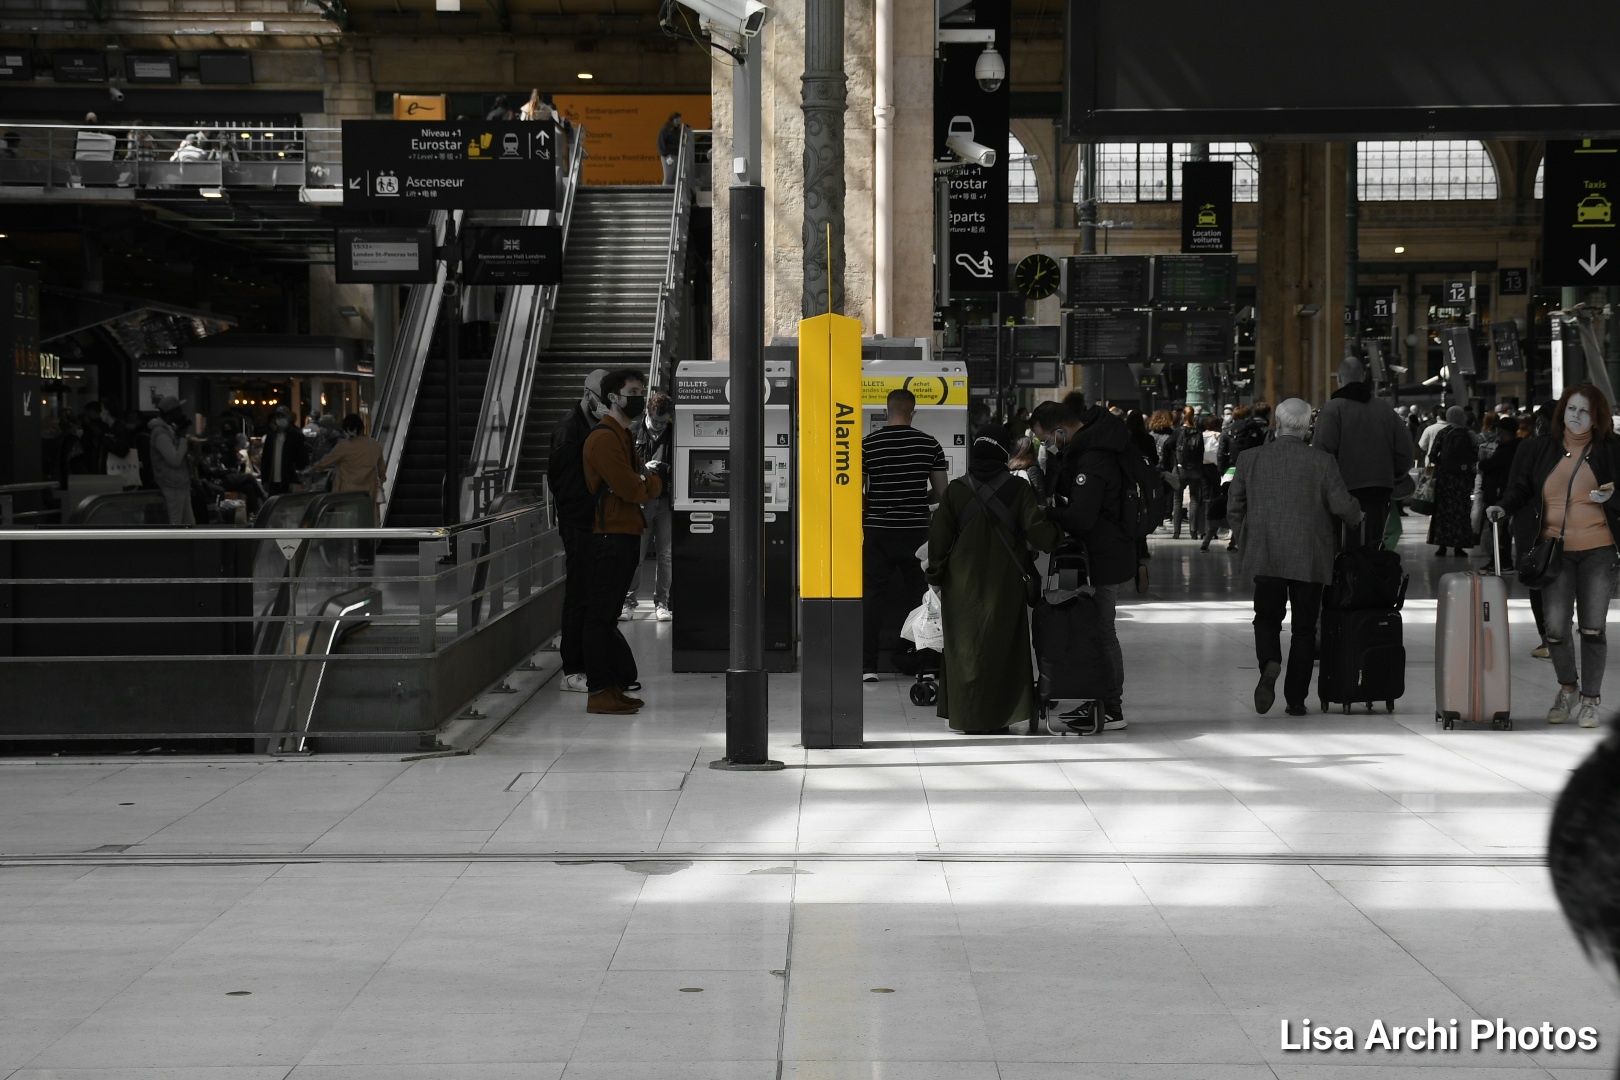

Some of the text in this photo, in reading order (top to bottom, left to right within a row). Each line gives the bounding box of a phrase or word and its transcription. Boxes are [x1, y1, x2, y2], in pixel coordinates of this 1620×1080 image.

[585, 107, 638, 116] Embarquement
[421, 128, 462, 138] Niveau +1
[411, 138, 462, 151] Eurostar
[622, 153, 655, 161] frontières
[971, 167, 982, 176] +1
[405, 176, 464, 188] Ascenseur
[950, 178, 988, 189] rostar
[1583, 180, 1607, 189] Taxis
[1192, 229, 1221, 237] Location
[1193, 236, 1221, 244] voitures
[1505, 277, 1522, 289] 13
[1449, 288, 1466, 300] 12
[1374, 304, 1387, 315] 11
[1344, 311, 1352, 322] 0
[40, 353, 62, 380] PAUL
[835, 402, 855, 486] Alarme
